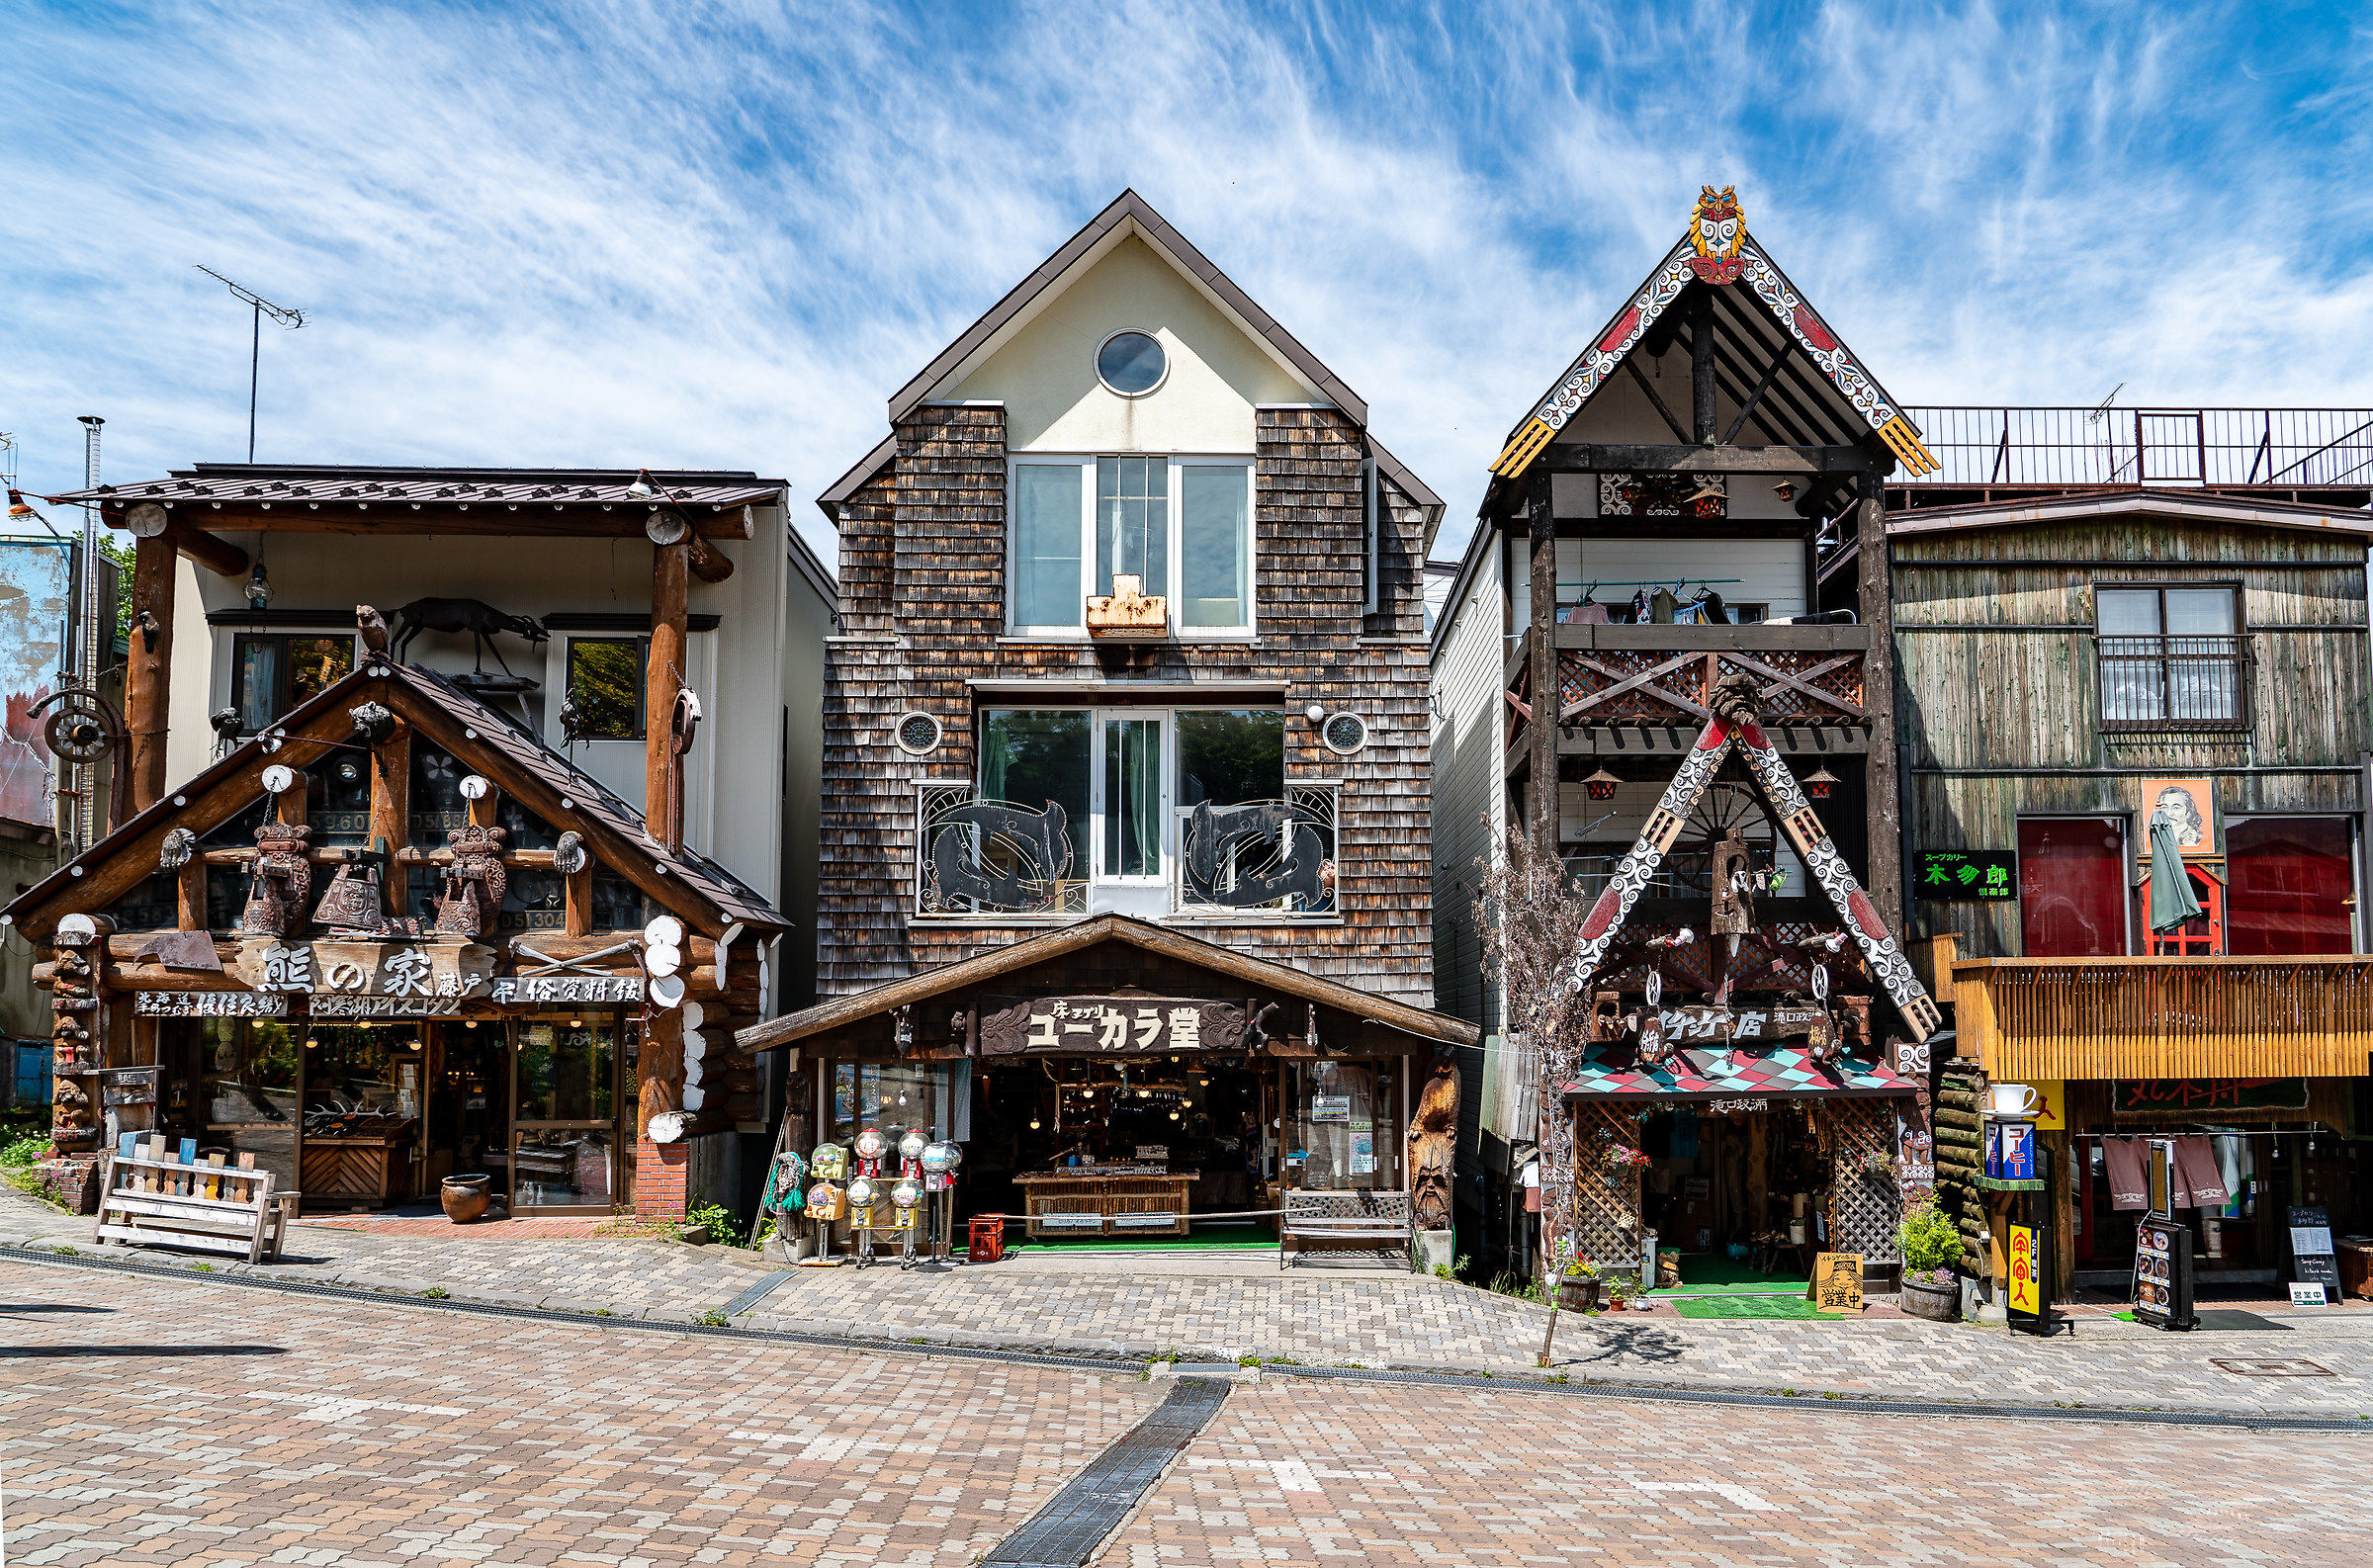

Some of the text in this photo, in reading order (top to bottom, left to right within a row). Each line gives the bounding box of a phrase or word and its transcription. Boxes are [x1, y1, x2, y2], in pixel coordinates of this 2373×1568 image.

[1924, 863, 2008, 887] 木多郎
[257, 941, 483, 999] 熊の家 藤戸
[138, 992, 191, 1004] 北海道
[1027, 1006, 1201, 1050] ユーカラ堂
[1988, 1127, 1997, 1176] コーヒー
[2009, 1128, 2025, 1176] コーヒー
[2031, 1239, 2038, 1257] 2F
[1821, 1289, 1860, 1309] 営業中
